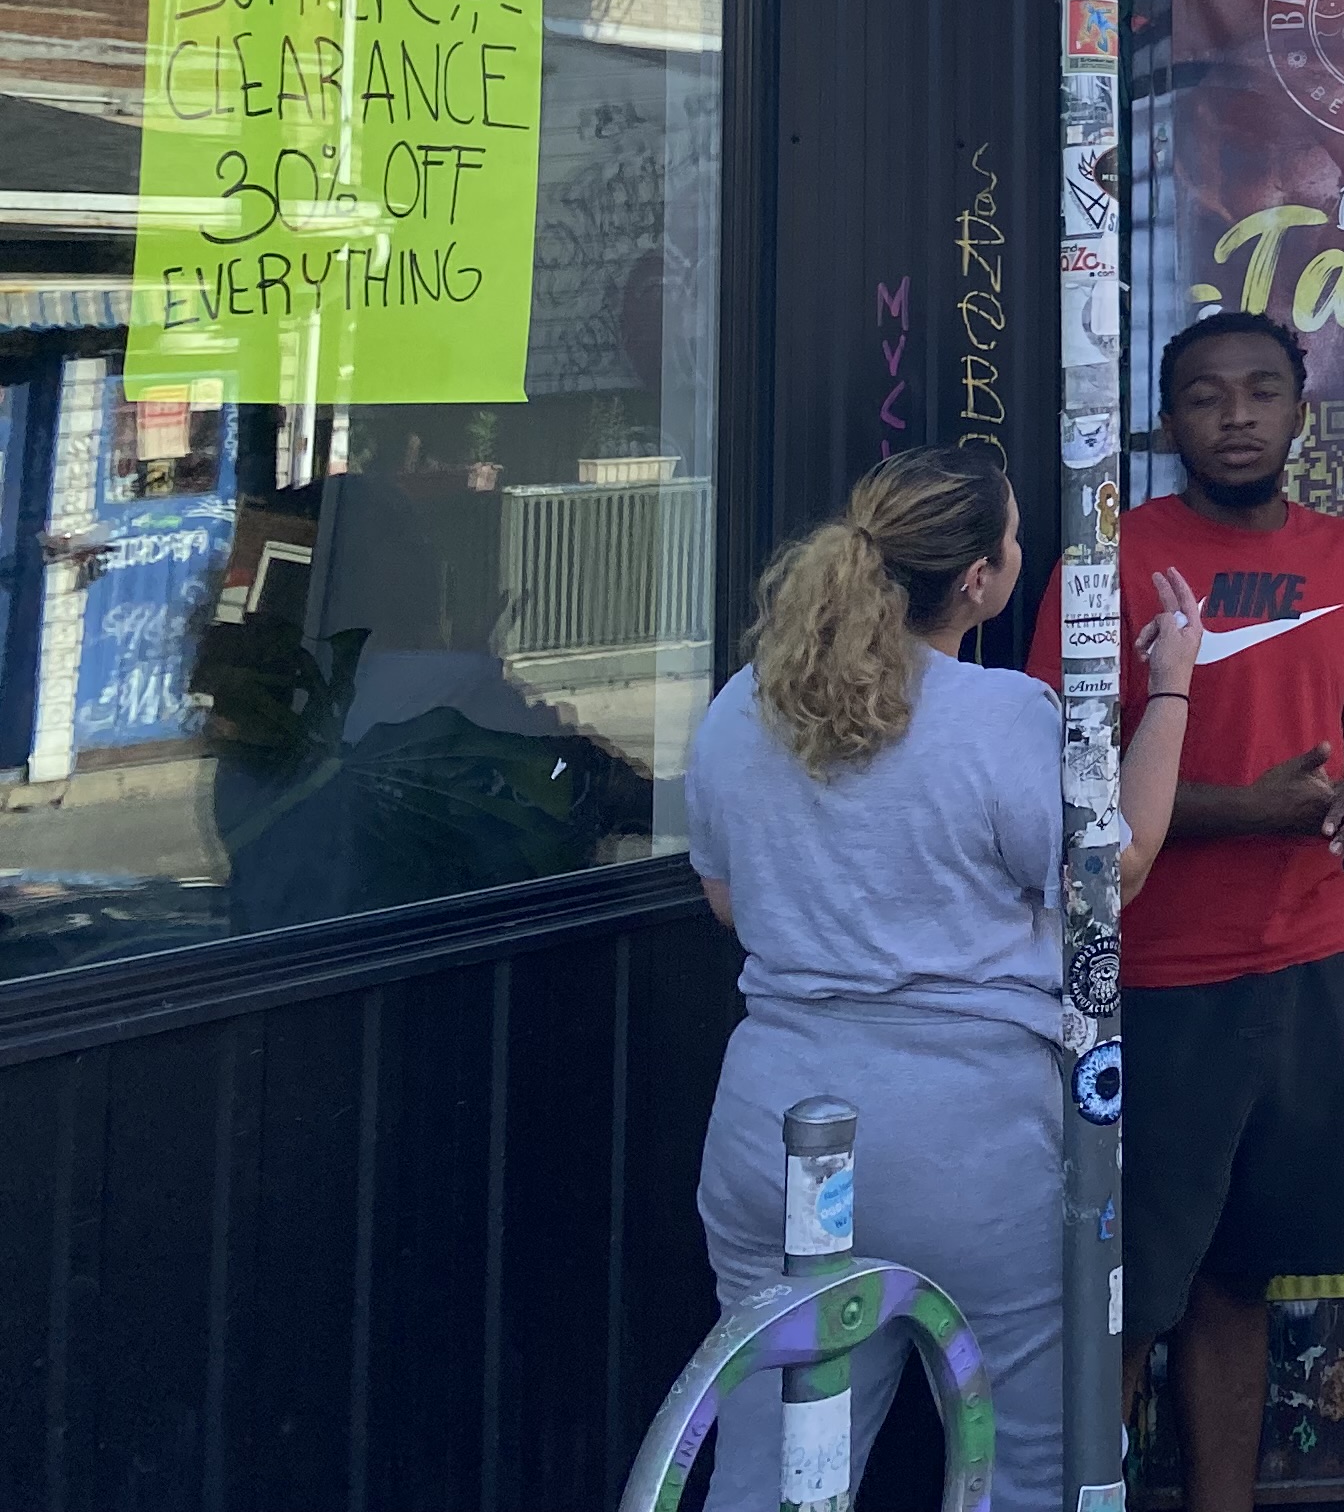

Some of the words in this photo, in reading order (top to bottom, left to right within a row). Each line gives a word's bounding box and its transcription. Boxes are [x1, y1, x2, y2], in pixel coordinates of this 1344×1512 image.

[166, 31, 530, 130] CLEARANCE
[200, 142, 358, 245] 30%
[384, 140, 486, 225] OFF
[163, 241, 483, 330] EVERYTHING
[1204, 571, 1307, 622] NIKE
